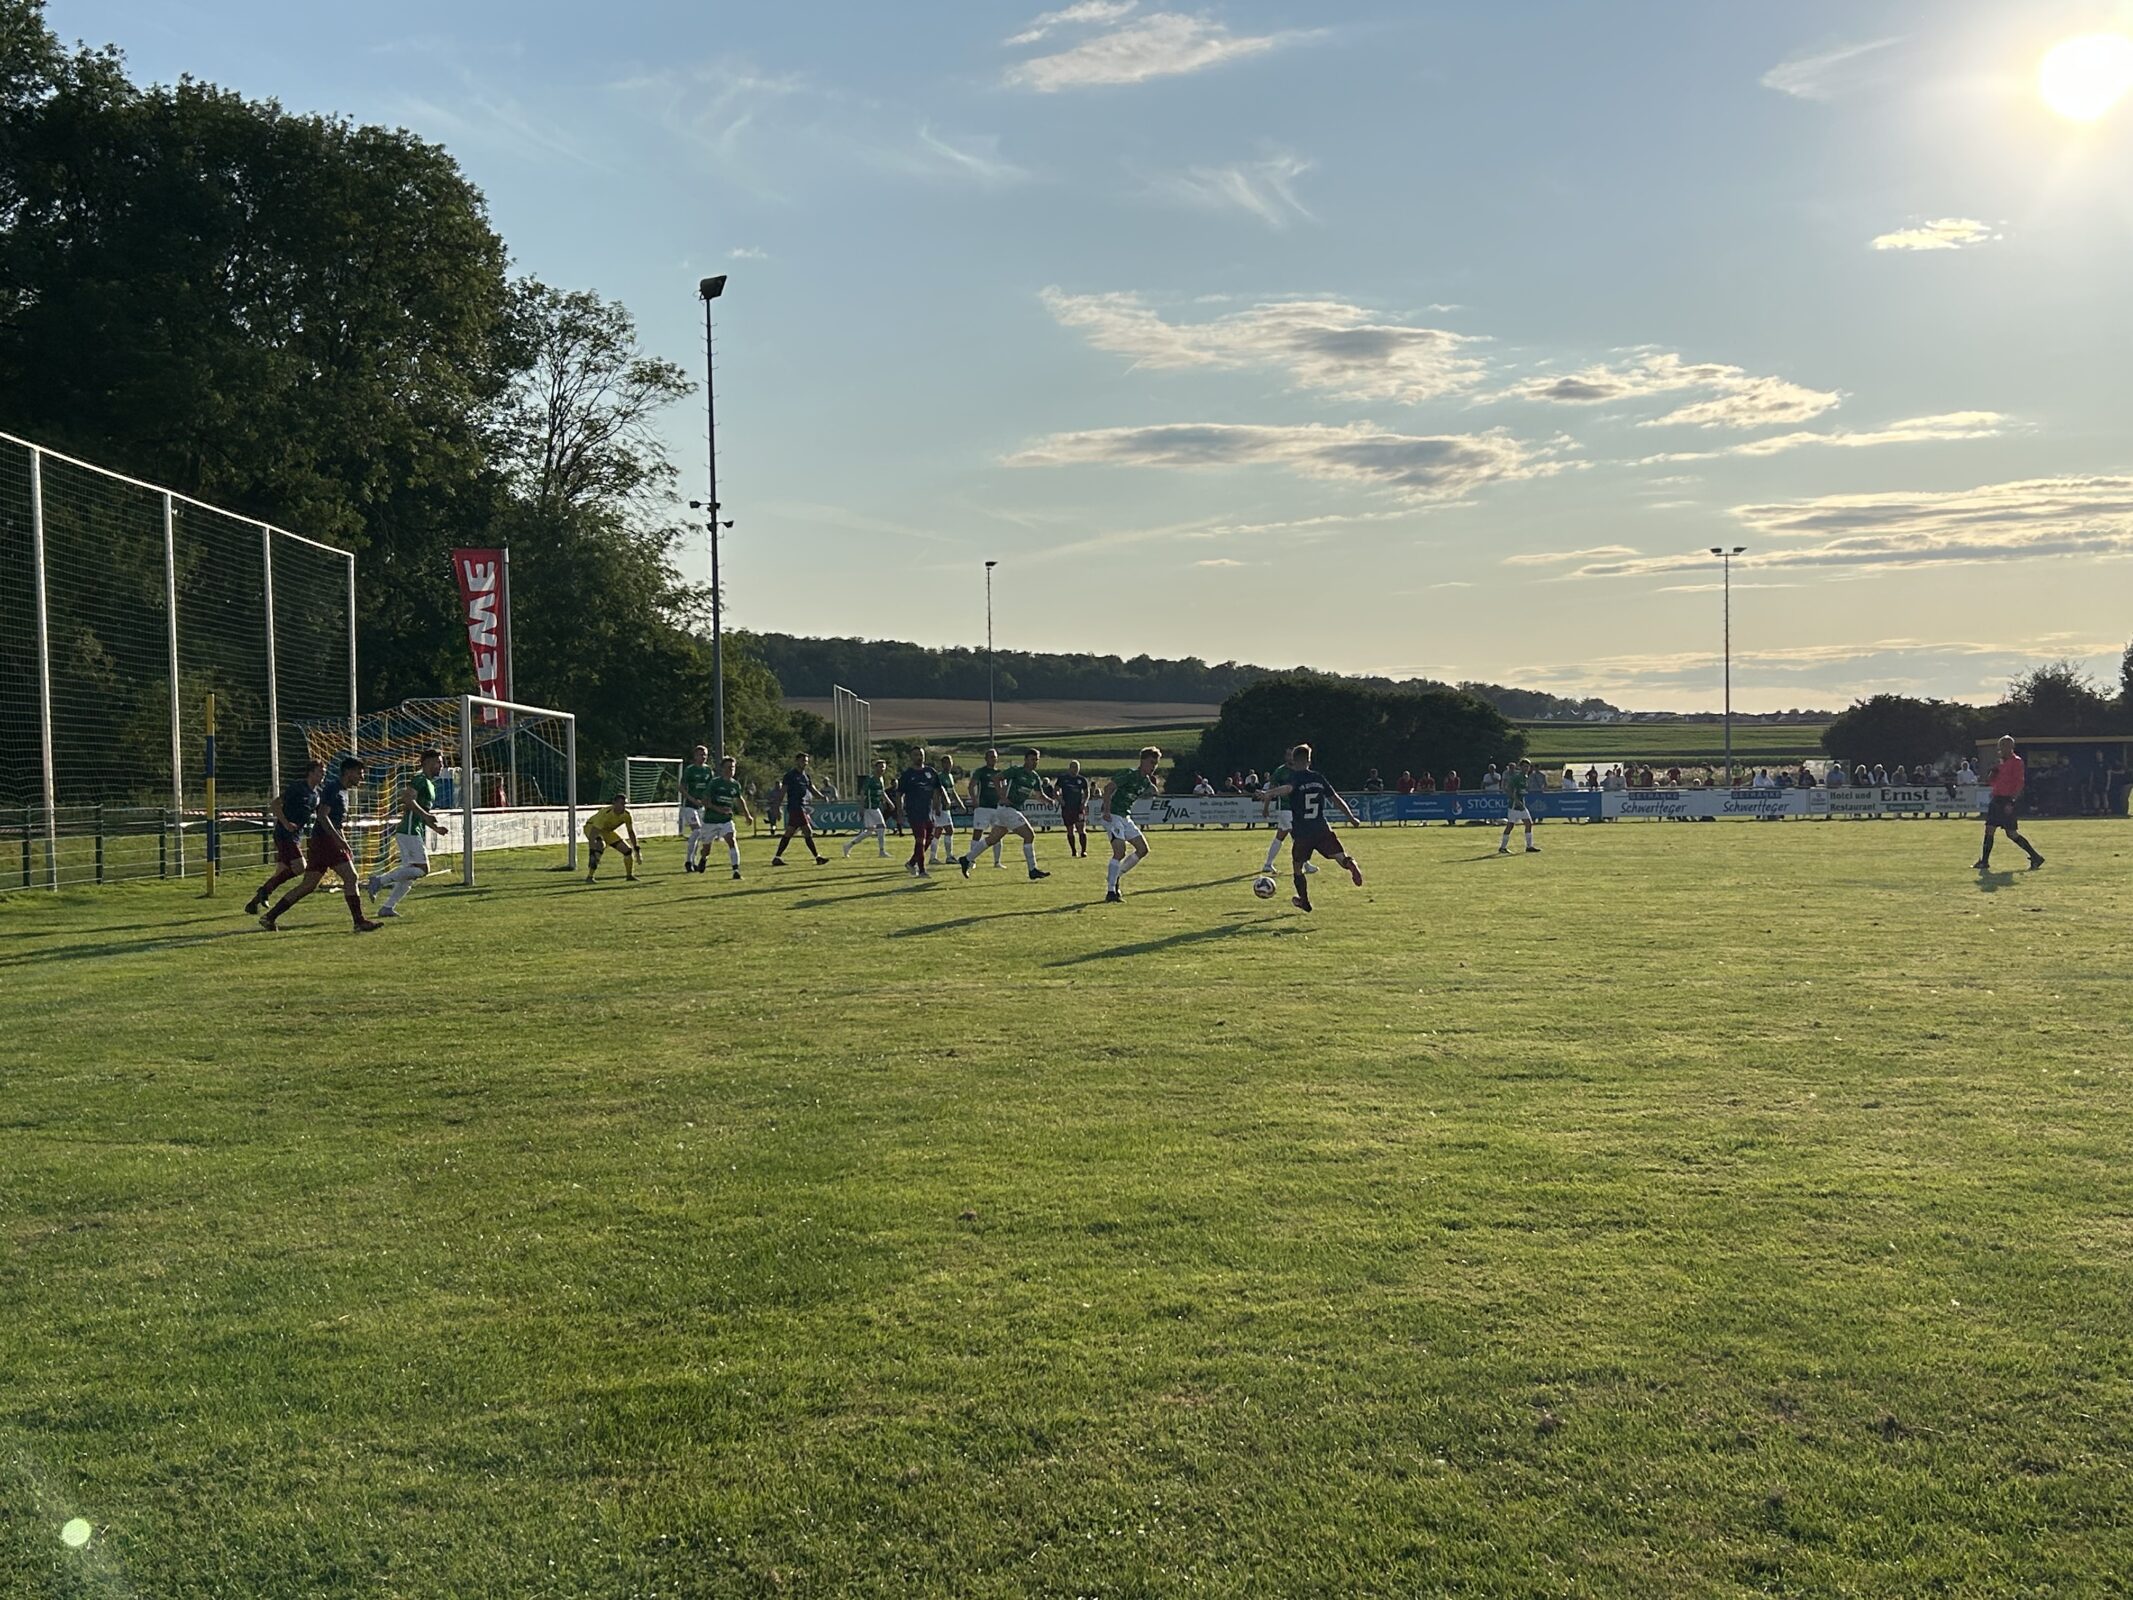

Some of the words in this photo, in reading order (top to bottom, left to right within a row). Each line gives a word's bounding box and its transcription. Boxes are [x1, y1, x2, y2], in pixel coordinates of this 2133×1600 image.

[1830, 791, 1853, 800] Hotel
[1855, 792, 1872, 800] und
[1881, 788, 1930, 801] Ernst
[1304, 793, 1320, 819] 5
[1620, 800, 1687, 815] Schwertfeger
[1723, 799, 1790, 815] Schwertfeger
[1830, 803, 1876, 811] Restaurant
